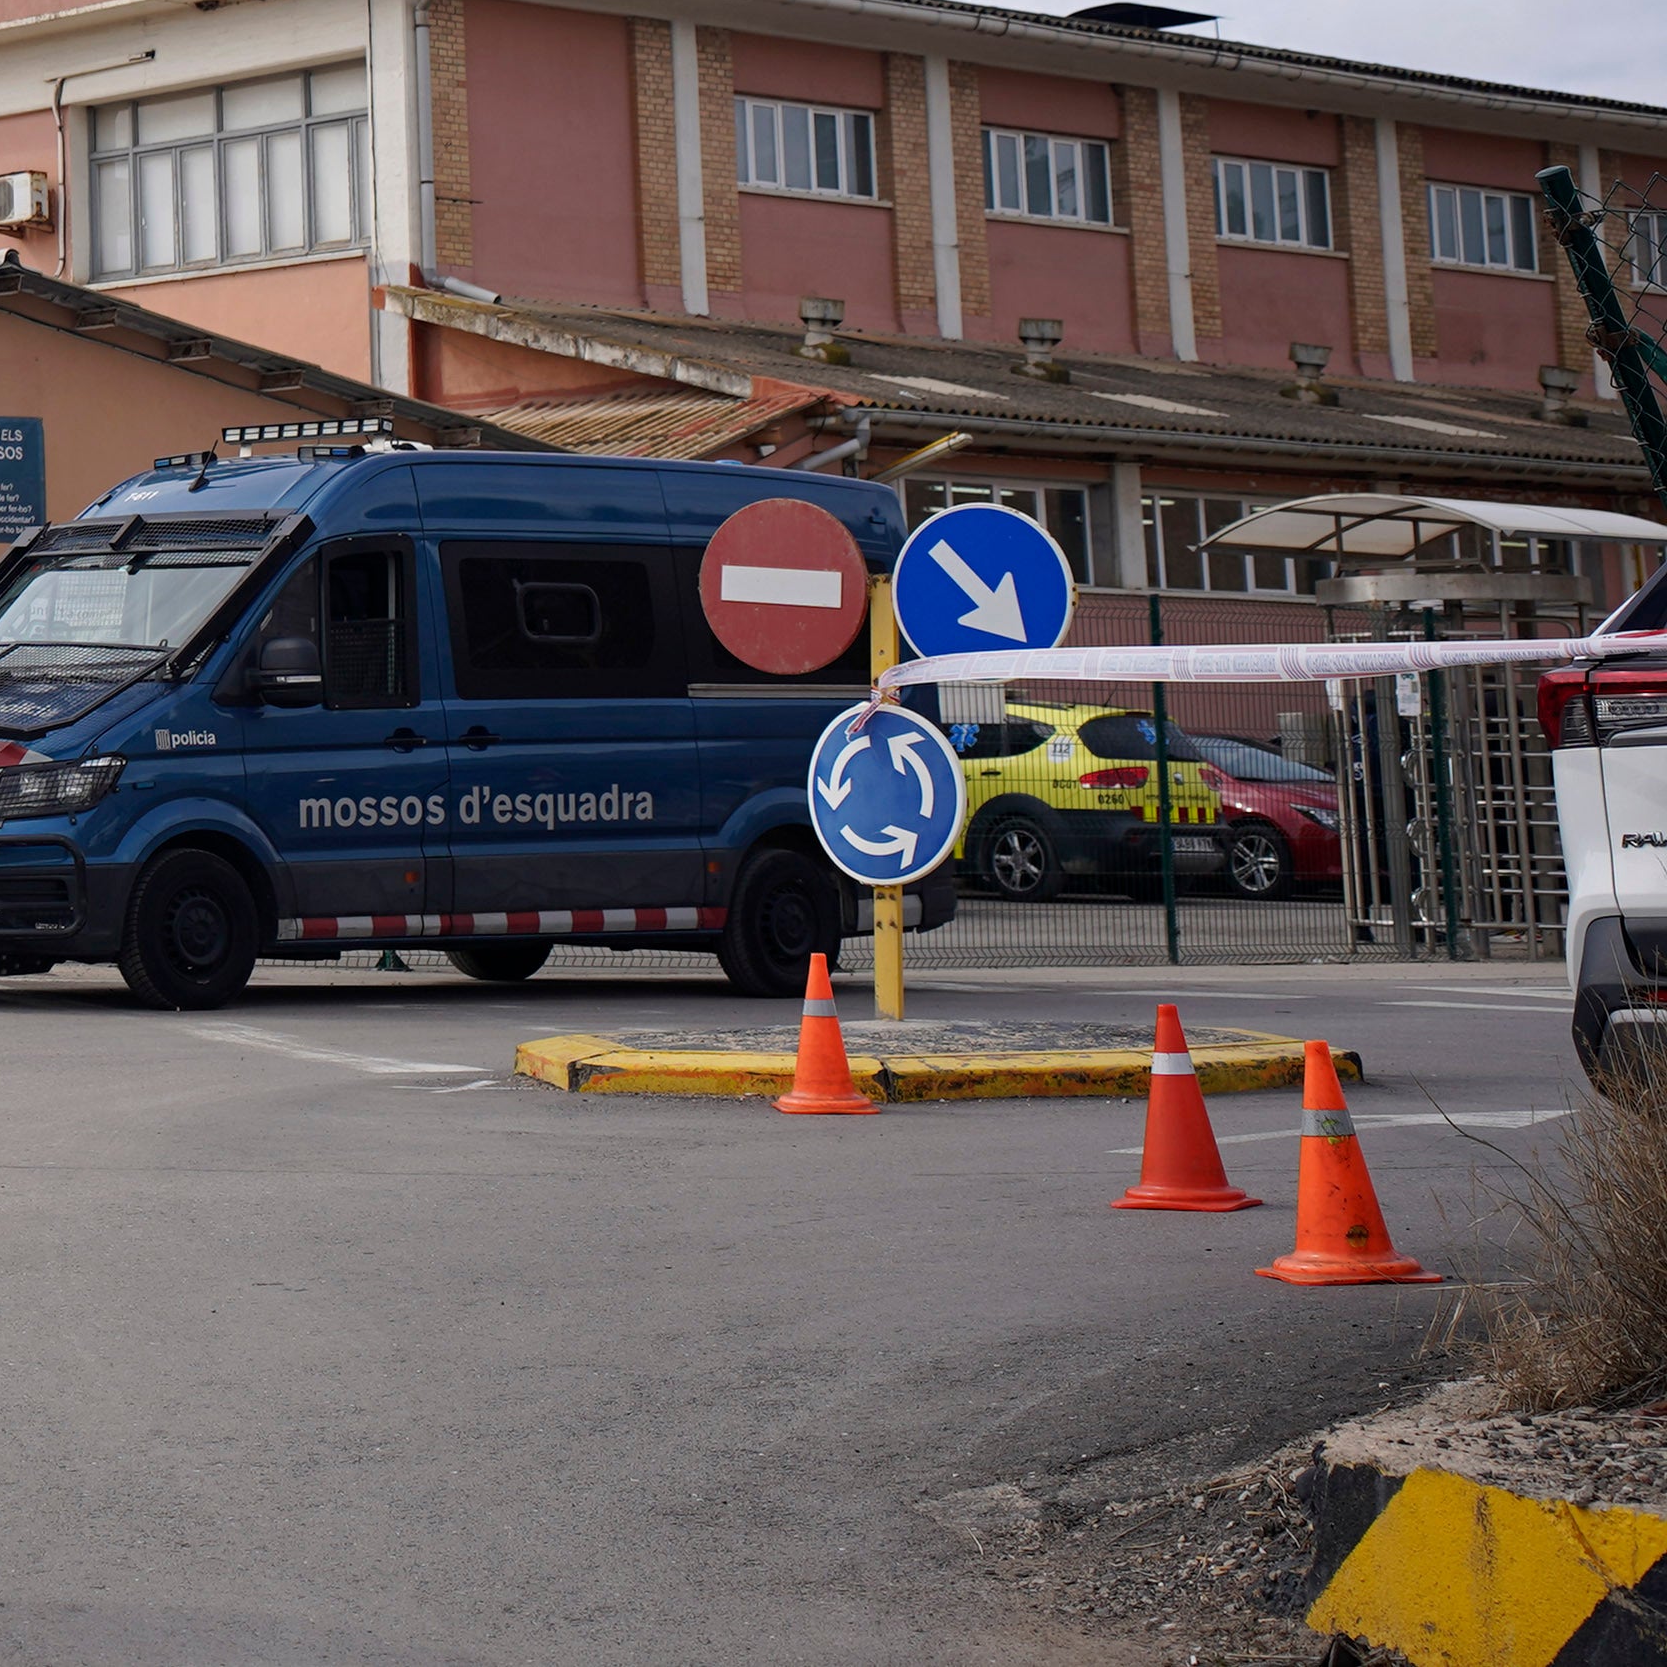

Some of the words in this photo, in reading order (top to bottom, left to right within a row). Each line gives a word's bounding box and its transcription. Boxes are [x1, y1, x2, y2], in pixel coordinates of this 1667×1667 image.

[1, 429, 23, 442] ELS
[171, 730, 216, 748] policia
[299, 794, 445, 828] mossos
[1621, 832, 1667, 848] RAV
